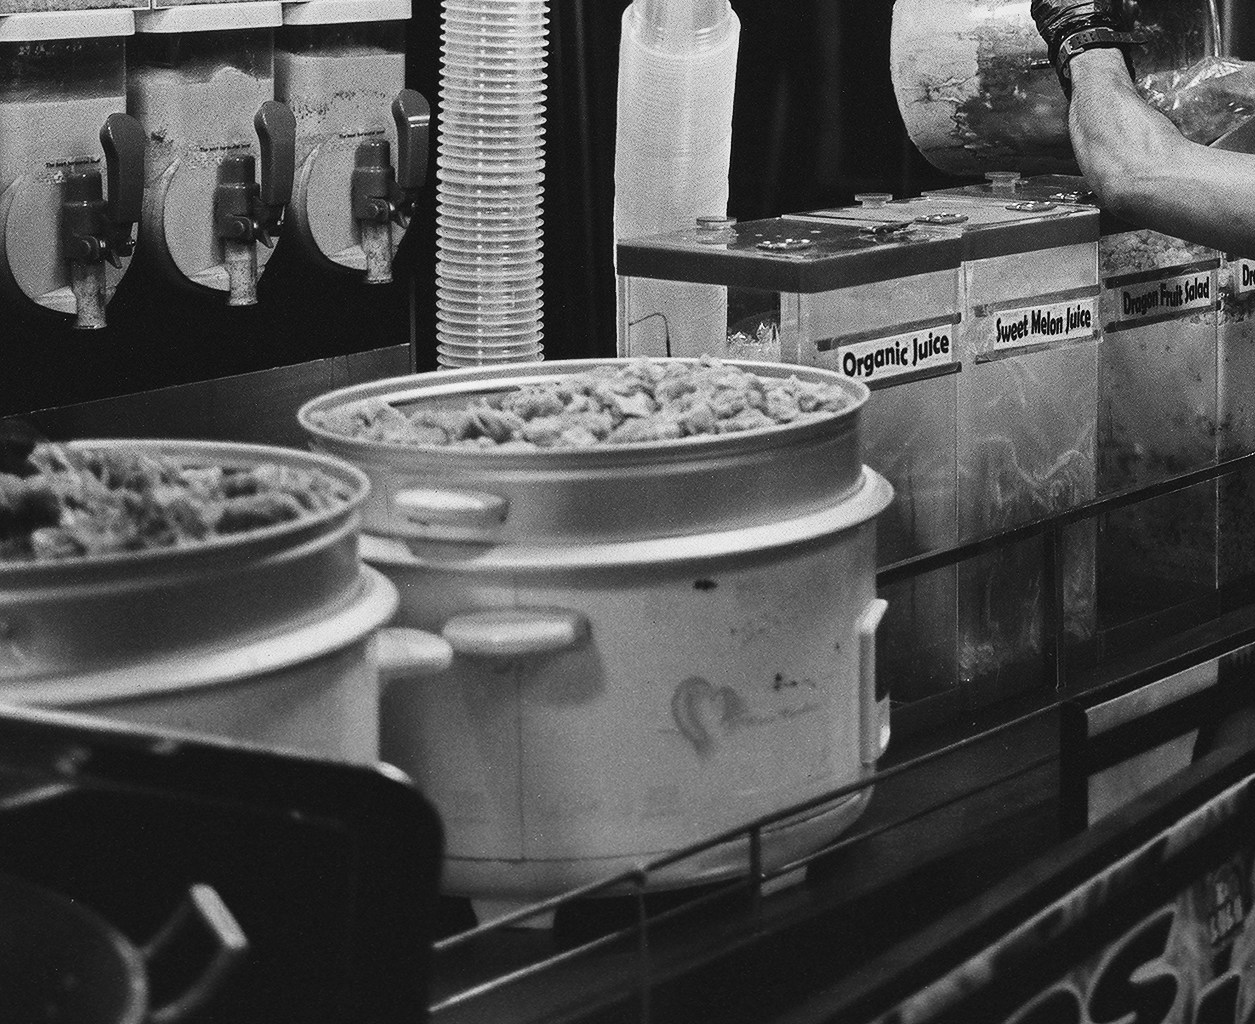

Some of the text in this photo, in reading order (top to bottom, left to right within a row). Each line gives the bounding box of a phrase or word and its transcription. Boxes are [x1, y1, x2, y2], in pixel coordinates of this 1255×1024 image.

[1123, 276, 1210, 316] Dragon Fruit Salad
[996, 306, 1091, 343] Sweet Melon Juice
[843, 333, 950, 377] Organic Juice
